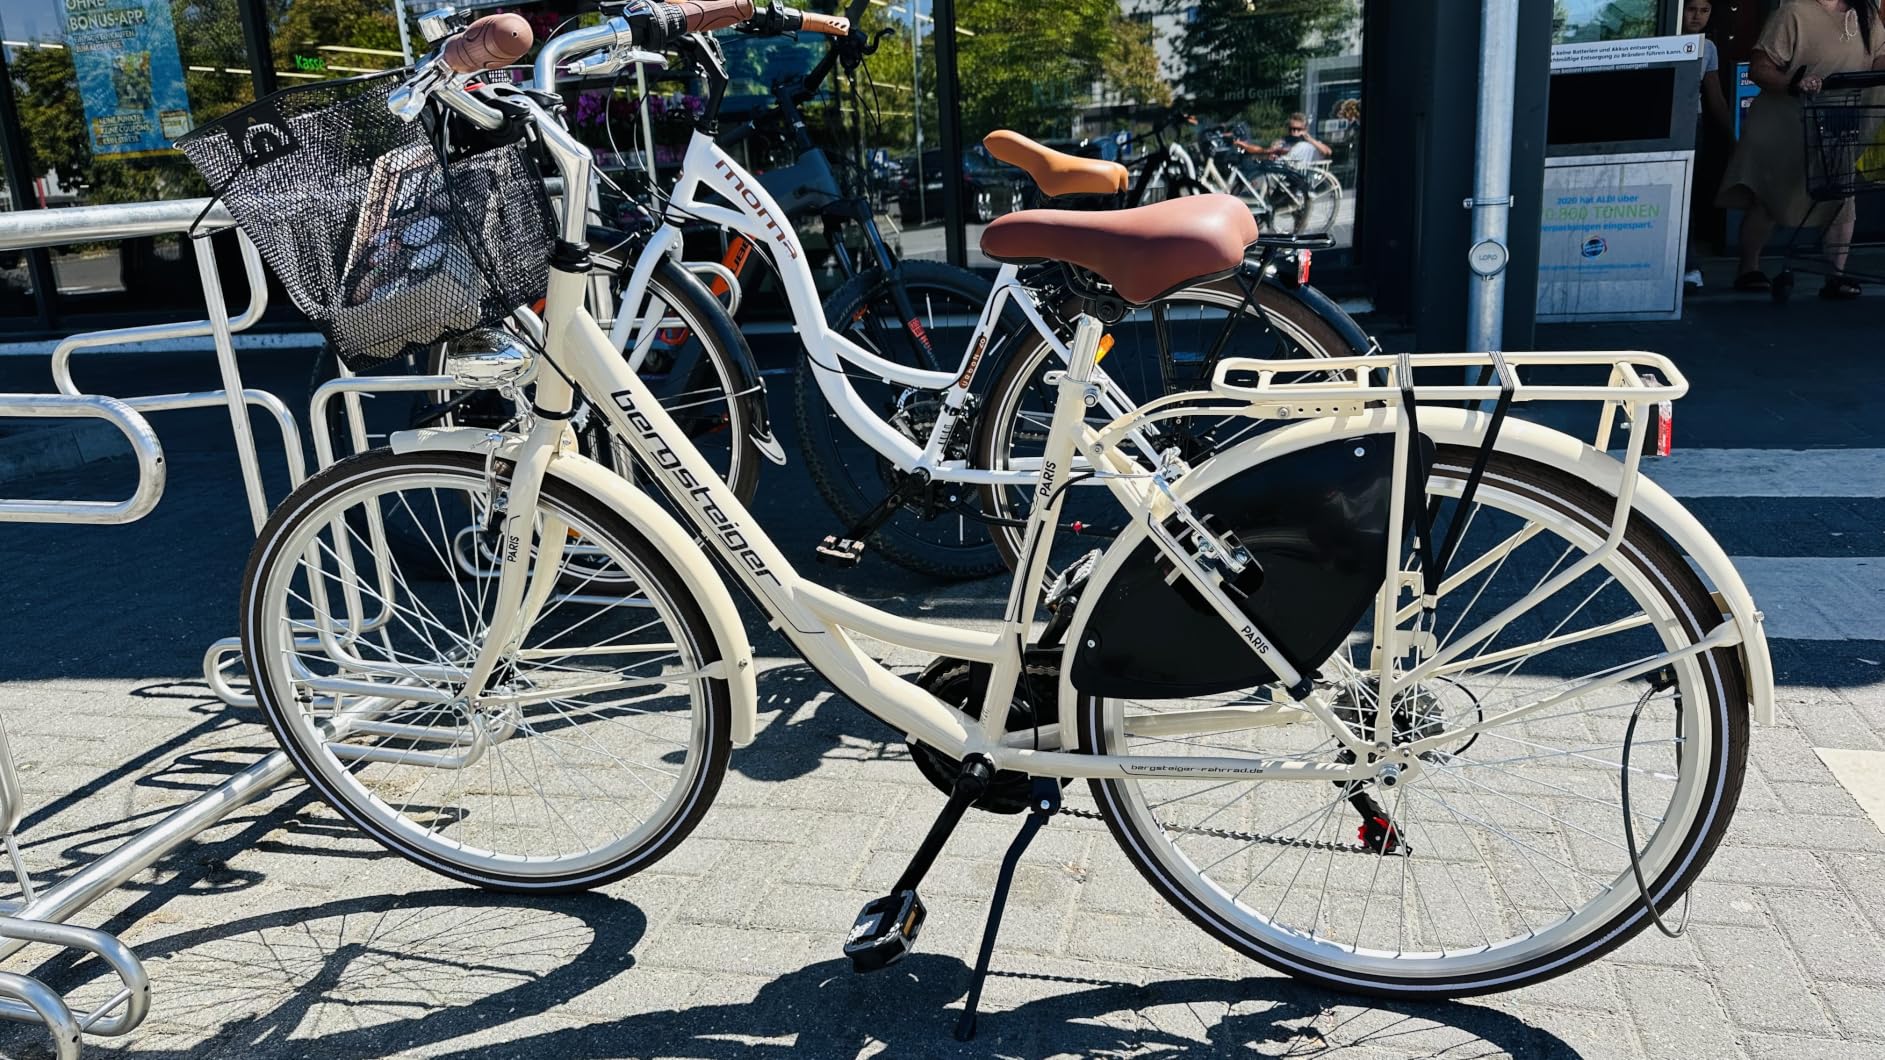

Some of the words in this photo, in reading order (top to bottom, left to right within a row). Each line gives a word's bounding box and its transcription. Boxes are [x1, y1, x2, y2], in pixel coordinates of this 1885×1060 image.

[69, 9, 146, 31] BONUS-APP.
[295, 54, 326, 71] Kasse
[1552, 54, 1580, 63] htmäßige
[1581, 53, 1613, 61] Entsorgung
[1621, 51, 1645, 59] Bränden
[1646, 49, 1666, 57] führen
[1579, 195, 1594, 204] hat
[1596, 194, 1616, 203] ALDI
[1617, 193, 1639, 203] über
[1594, 203, 1660, 219] TONNEN
[1603, 221, 1654, 231] eingespart.
[1039, 460, 1057, 498] PARIS
[611, 389, 781, 587] bergsteiger
[507, 535, 520, 563] PARIS
[1241, 625, 1269, 654] PARIS
[1130, 764, 1264, 774] bergsteiger-fahrrad.de
